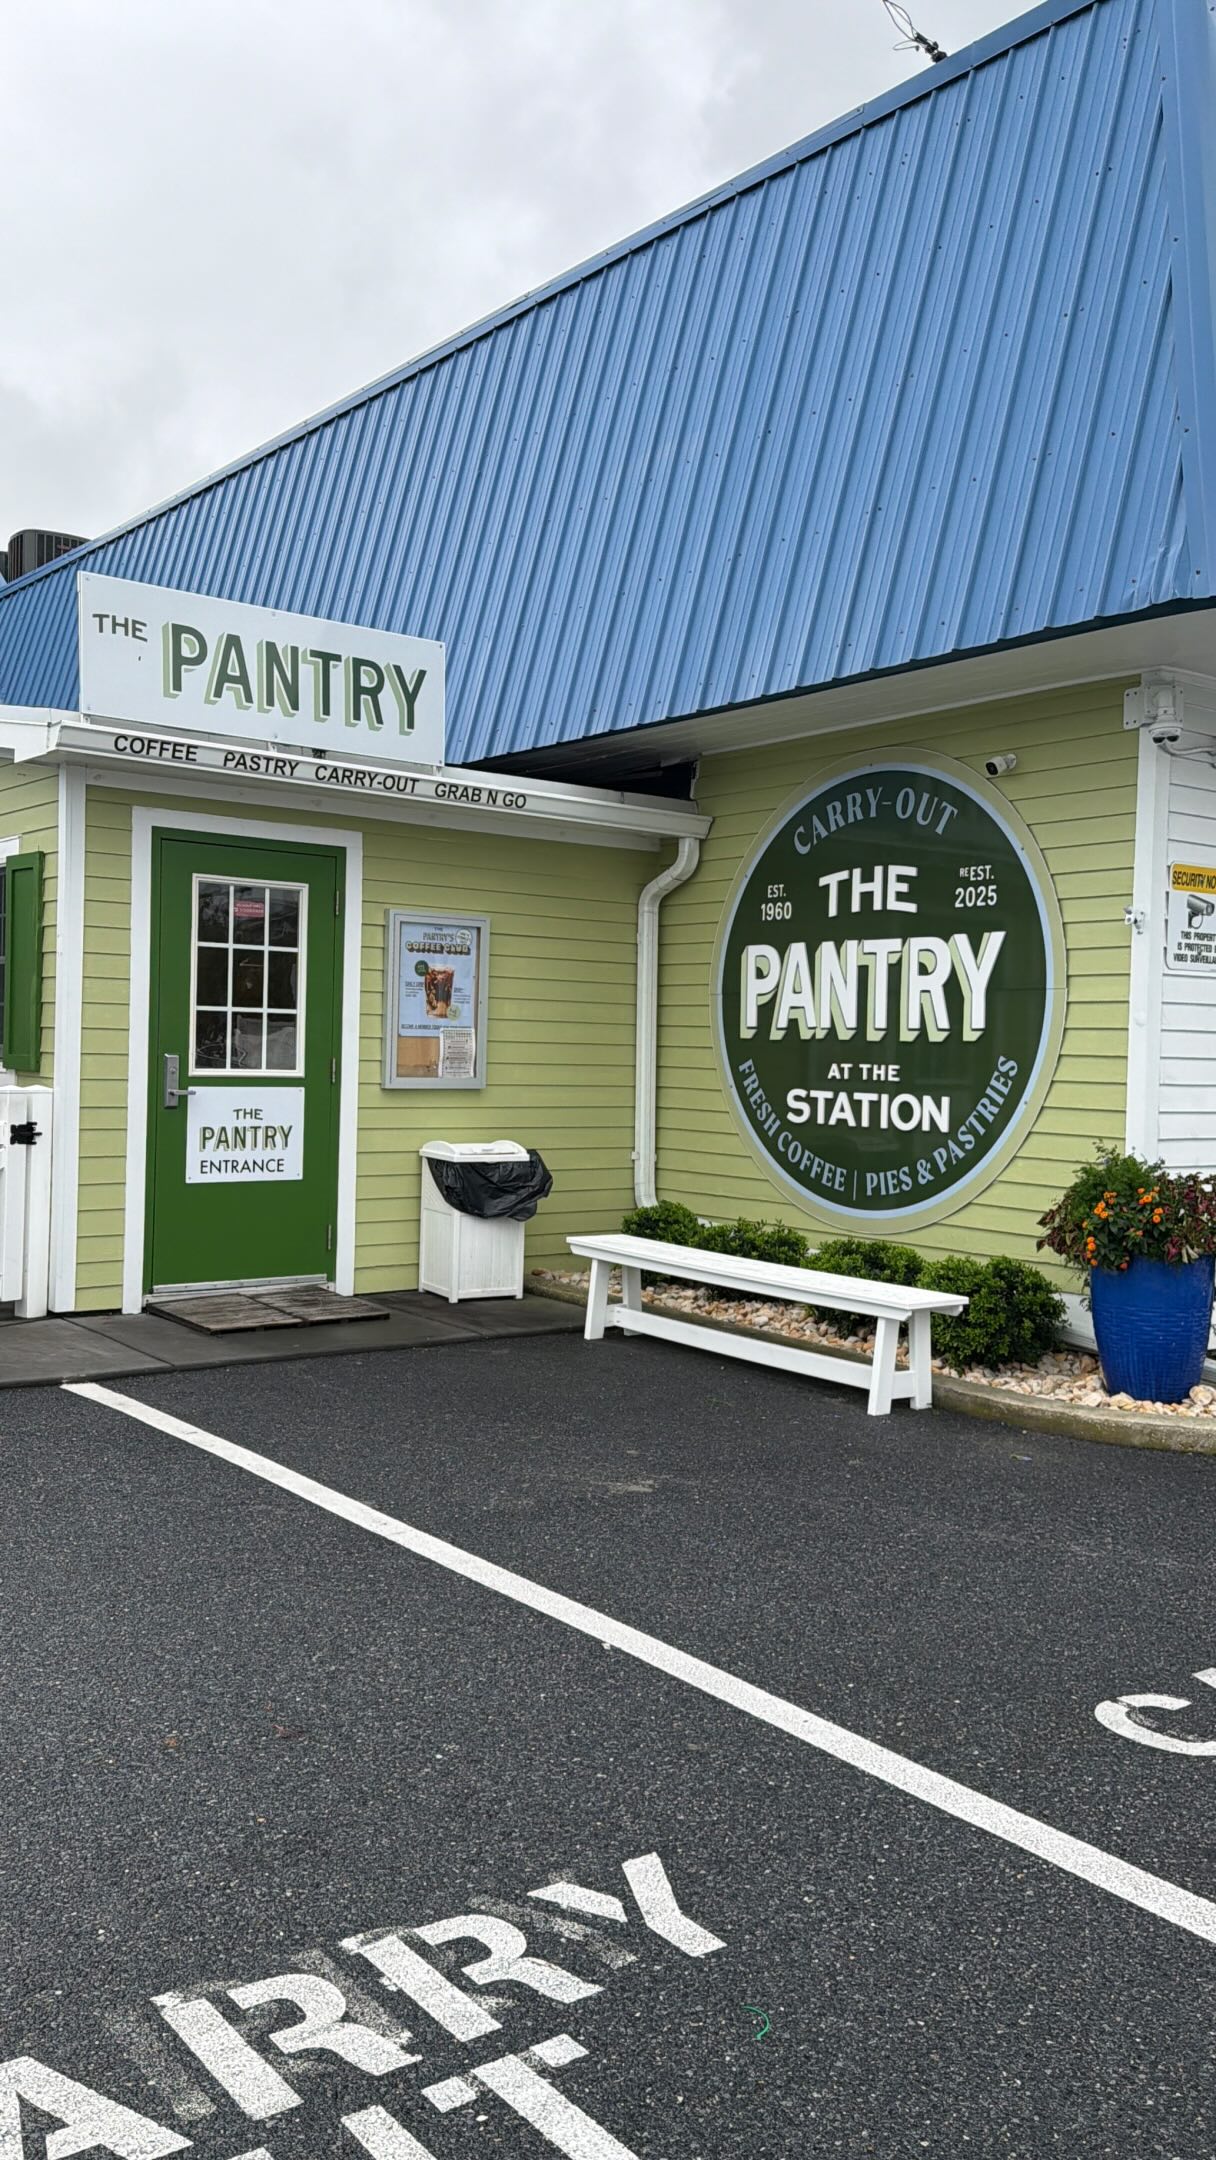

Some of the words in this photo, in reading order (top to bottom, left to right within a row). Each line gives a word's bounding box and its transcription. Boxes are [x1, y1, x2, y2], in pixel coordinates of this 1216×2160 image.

[92, 613, 148, 642] THE
[162, 621, 428, 736] PANTRY
[114, 735, 198, 762] COFFEE
[223, 751, 299, 777] PASTRY
[315, 765, 420, 794] CARRY-OUT
[434, 782, 482, 804] GRAB
[487, 789, 498, 805] N
[502, 792, 527, 809] GO
[794, 786, 959, 855] CARRY-OUT
[767, 884, 787, 898] EST.
[818, 864, 918, 918] THE
[1172, 870, 1206, 889] SECURITY
[954, 885, 997, 908] 2025
[761, 902, 792, 921] 1960
[406, 941, 444, 954] COFFEE
[1181, 931, 1192, 940] THIS
[740, 931, 1006, 1042] PANTRY
[827, 1063, 853, 1079] AT
[859, 1064, 900, 1082] THE
[233, 1108, 263, 1120] THE
[786, 1088, 950, 1133] STATION
[738, 1058, 781, 1138] FRESH
[777, 1131, 847, 1192] COFFEE
[866, 1165, 913, 1196] PIES
[916, 1158, 933, 1184] &
[932, 1055, 1018, 1174] PASTRIES
[199, 1125, 293, 1152] PANTRY
[200, 1158, 285, 1174] ENTRANCE
